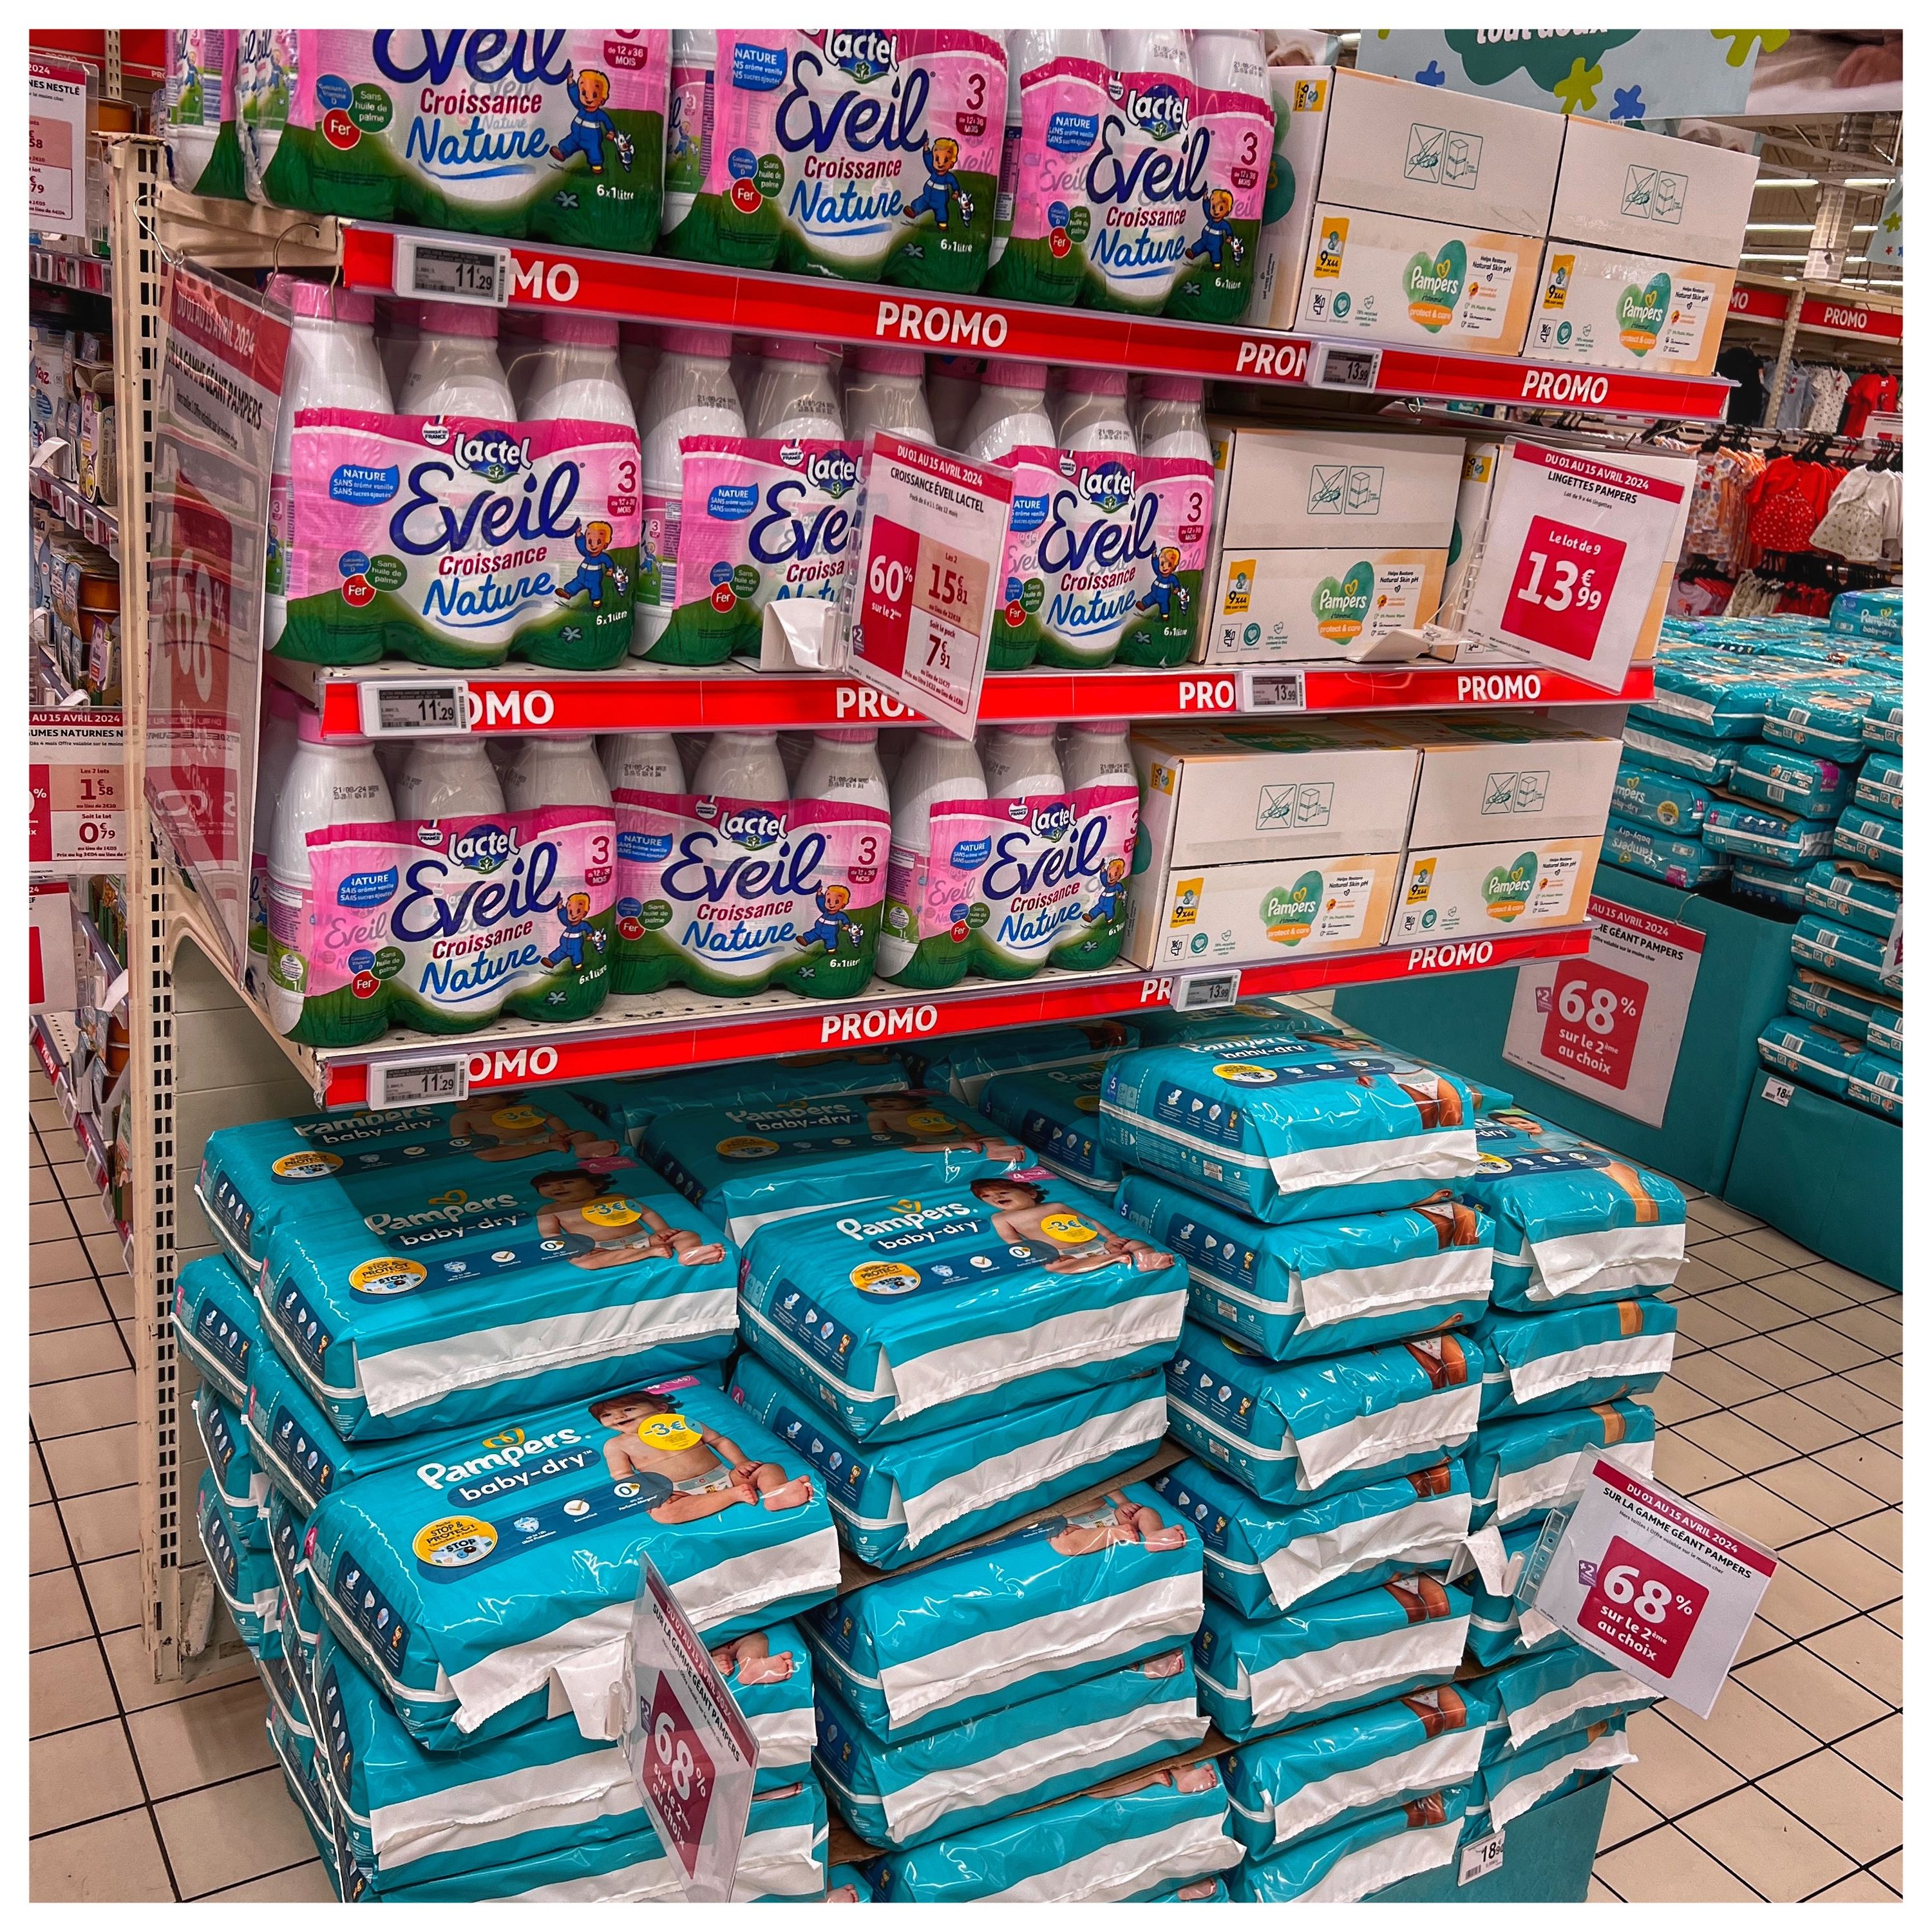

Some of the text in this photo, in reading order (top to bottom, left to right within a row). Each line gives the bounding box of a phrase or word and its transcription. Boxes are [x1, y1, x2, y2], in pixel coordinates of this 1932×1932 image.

[615, 55, 636, 66] MOIS
[825, 29, 899, 70] lactel
[46, 83, 80, 96] NESTLÉ
[361, 90, 382, 101] Sans
[421, 88, 542, 115] Croissance
[775, 51, 931, 153] Eveil
[359, 112, 384, 124] palme
[1126, 90, 1189, 128] lactel
[330, 120, 351, 137] Fer
[406, 117, 549, 165] Nature
[804, 155, 902, 180] Croissance
[1085, 114, 1211, 205] Eveil
[789, 180, 904, 223] Nature
[1106, 206, 1186, 227] Croissance
[1090, 228, 1186, 267] Nature
[1411, 265, 1459, 295] Pampers
[1472, 261, 1492, 270] Natural
[1503, 265, 1512, 274] pH
[876, 301, 1008, 348] PROMO
[1622, 297, 1663, 323] Pampers
[1824, 307, 1867, 328] PROMO
[1521, 370, 1609, 404] PROMO
[453, 432, 533, 470] lactel
[897, 444, 983, 487] DU 01 AU 15 AVRIL 2024
[343, 469, 386, 482] NATURE
[1079, 468, 1136, 500] lactel
[1546, 453, 1649, 490] DU 01 AU 15 AVRIL 2024
[333, 488, 352, 497] SANS
[890, 466, 984, 513] CROISSANCE ÉVEIL LACTEL
[1548, 471, 1638, 504] LINGETTES PAMPERS
[389, 460, 581, 556] Eveil
[1593, 497, 1612, 510] lingettes
[1037, 489, 1159, 574] Eveil
[1549, 531, 1602, 555] Le lot de 9
[372, 567, 402, 578] huile de
[377, 560, 397, 569] Sans
[439, 545, 547, 576] Croissance
[375, 576, 398, 586] palme
[1061, 567, 1137, 592] Croissance
[1410, 576, 1419, 585] pH
[422, 573, 555, 618] Nature
[871, 602, 889, 616] sur le
[1046, 590, 1137, 625] Nature
[1319, 589, 1367, 611] Pampers
[929, 620, 939, 630] Soit
[944, 625, 956, 639] pack
[1320, 623, 1341, 633] protect
[1861, 609, 1897, 627] Pampers
[1862, 625, 1893, 638] baby-dry
[1179, 680, 1234, 708] PRO
[1457, 674, 1541, 701] PROMO
[719, 811, 789, 841] lactel
[1030, 803, 1077, 837] lactel
[448, 827, 521, 866] lactel
[982, 815, 1108, 901] Eveil
[660, 831, 828, 902] Eveil
[391, 842, 562, 942] Eveil
[1010, 882, 1080, 913] Croissance
[1488, 876, 1531, 895] Pampers
[697, 900, 793, 921] Croissance
[996, 902, 1083, 942] Nature
[1268, 898, 1315, 917] Pampers
[1592, 903, 1669, 936] AU 15 AVRIL 2024
[433, 921, 533, 960] Croissance
[681, 921, 797, 952] Nature
[1609, 925, 1684, 961] GÉANT PAMPERS
[419, 944, 542, 994] Nature
[1408, 942, 1493, 971] PROMO
[821, 1005, 938, 1043] PROMO
[1559, 1030, 1580, 1043] sur
[1581, 1034, 1593, 1048] le
[469, 1046, 558, 1082] OMO
[1558, 1046, 1575, 1060] au
[1576, 1052, 1611, 1075] choix
[364, 1193, 520, 1235] Pampers
[837, 1200, 972, 1241] Pampers
[362, 1263, 410, 1276] PROTECT
[860, 1264, 900, 1278] PROTECT
[416, 1429, 587, 1490] Pampers
[431, 1524, 454, 1537] STOP
[1602, 1487, 1752, 1579] SUR LA GAMME GÉANT PAMPERS
[1626, 1483, 1738, 1553] DU 01 AU 15 AVRIL 2024
[446, 1539, 477, 1553] STOP
[1619, 1510, 1631, 1522] Hors
[1631, 1515, 1646, 1530] tailles
[1650, 1528, 1663, 1540] Offre
[1663, 1533, 1681, 1549] valable
[1696, 1556, 1712, 1569] moins
[1712, 1563, 1724, 1575] cher
[1600, 1605, 1668, 1645] sur le 2ème
[1598, 1622, 1616, 1637] au
[1618, 1631, 1658, 1662] choix
[652, 1603, 741, 1763] SUR LA GAMME GÉANT PAMPERS
[652, 1763, 675, 1804] sur le
[652, 1782, 686, 1851] au choix
